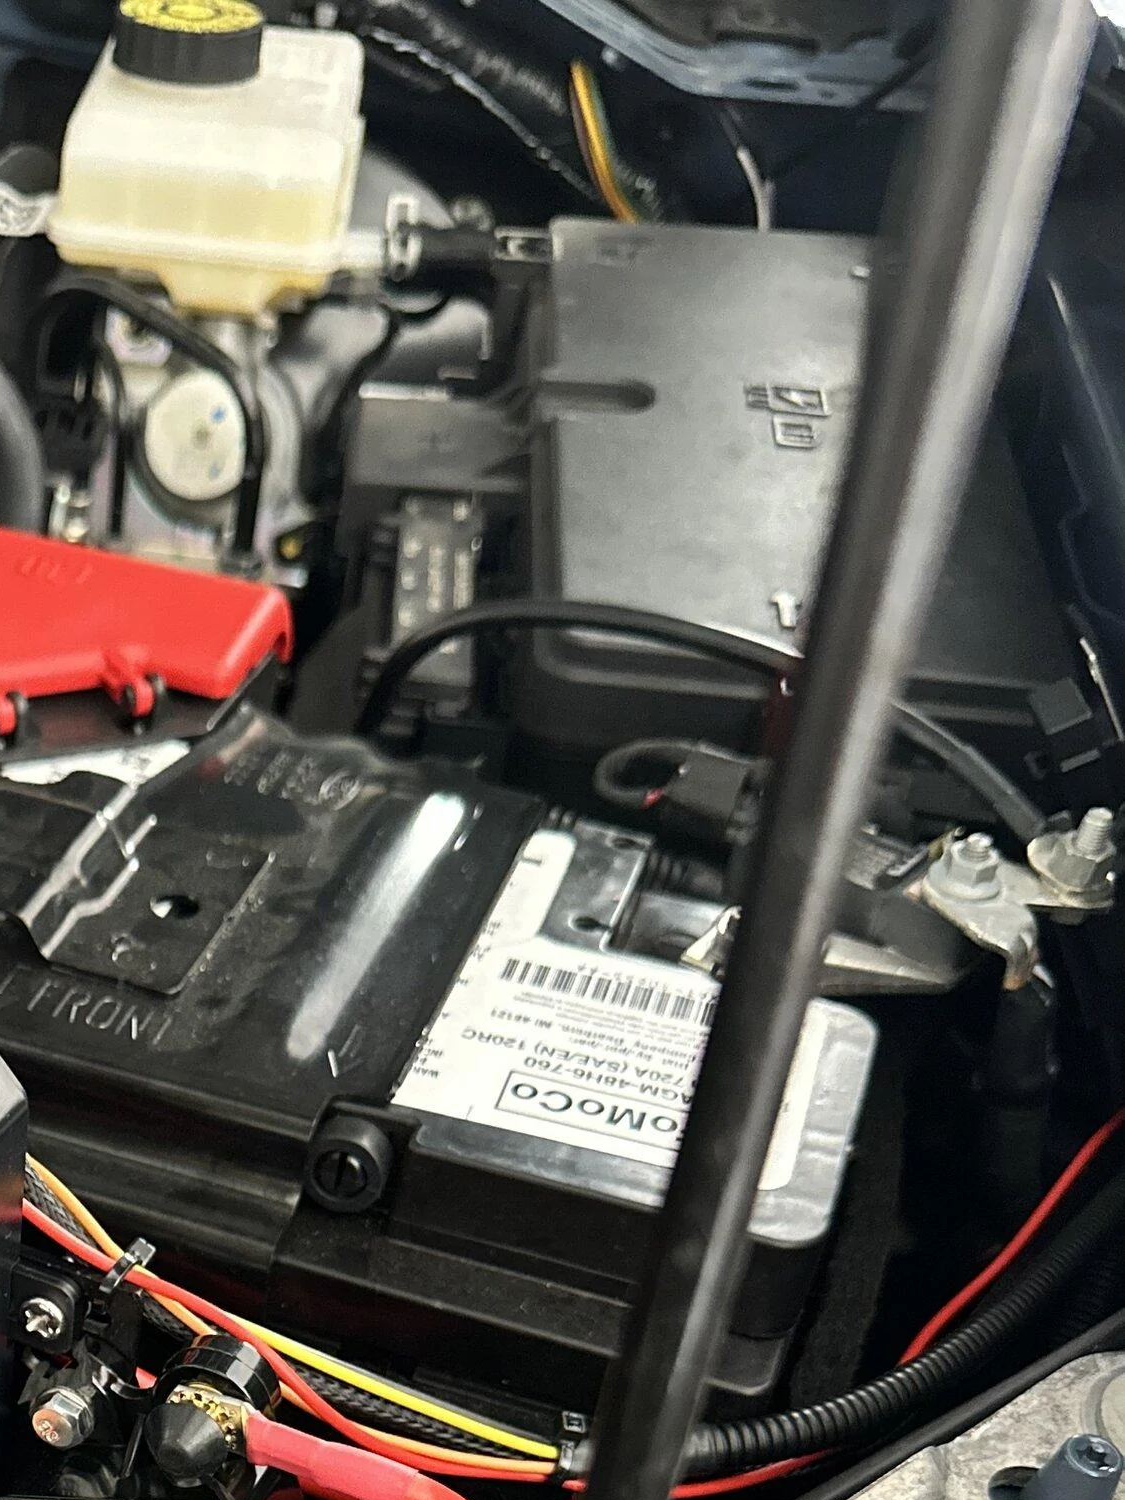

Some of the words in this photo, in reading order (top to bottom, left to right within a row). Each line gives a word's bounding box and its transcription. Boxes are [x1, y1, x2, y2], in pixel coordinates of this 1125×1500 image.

[26, 977, 187, 1047] FRONT
[534, 1039, 629, 1074] (SAE/EN)
[511, 1083, 683, 1141] oMoCo
